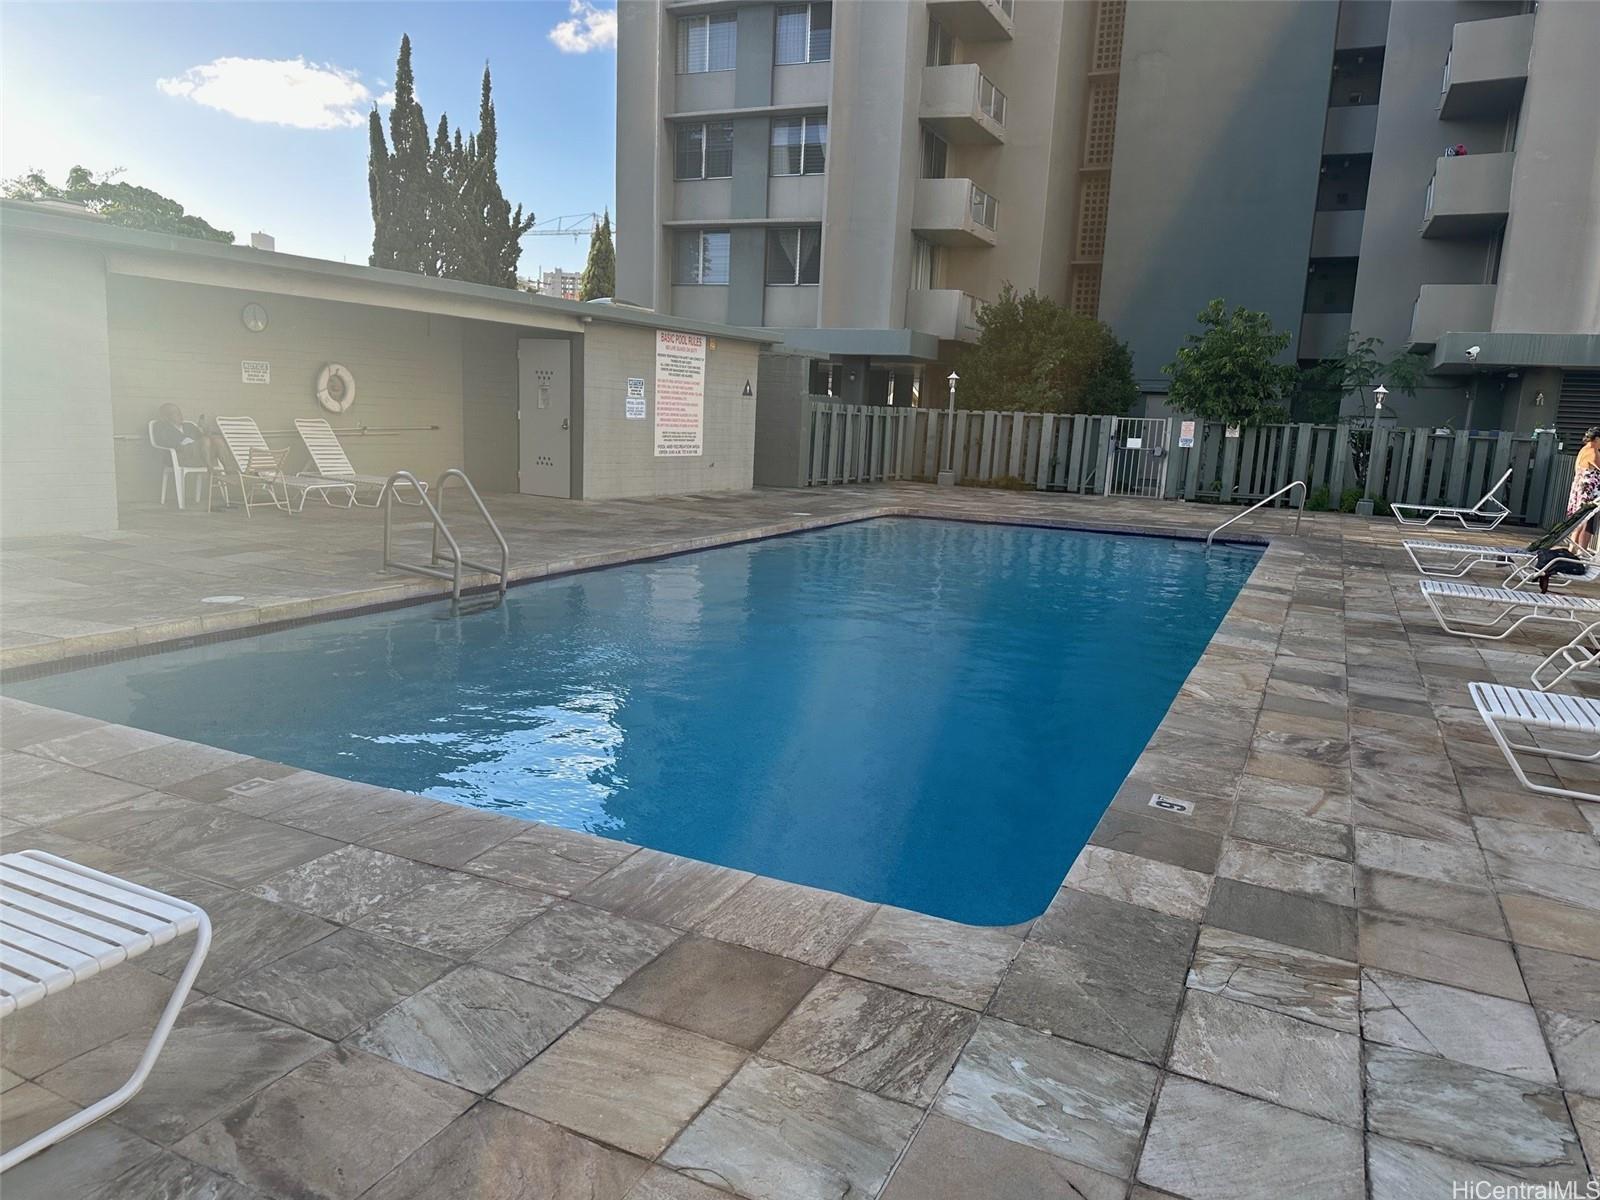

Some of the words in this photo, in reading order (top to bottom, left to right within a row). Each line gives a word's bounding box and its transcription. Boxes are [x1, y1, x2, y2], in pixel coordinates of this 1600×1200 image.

[661, 332, 675, 343] BASIC
[676, 334, 688, 345] POOL
[689, 336, 702, 347] RULES
